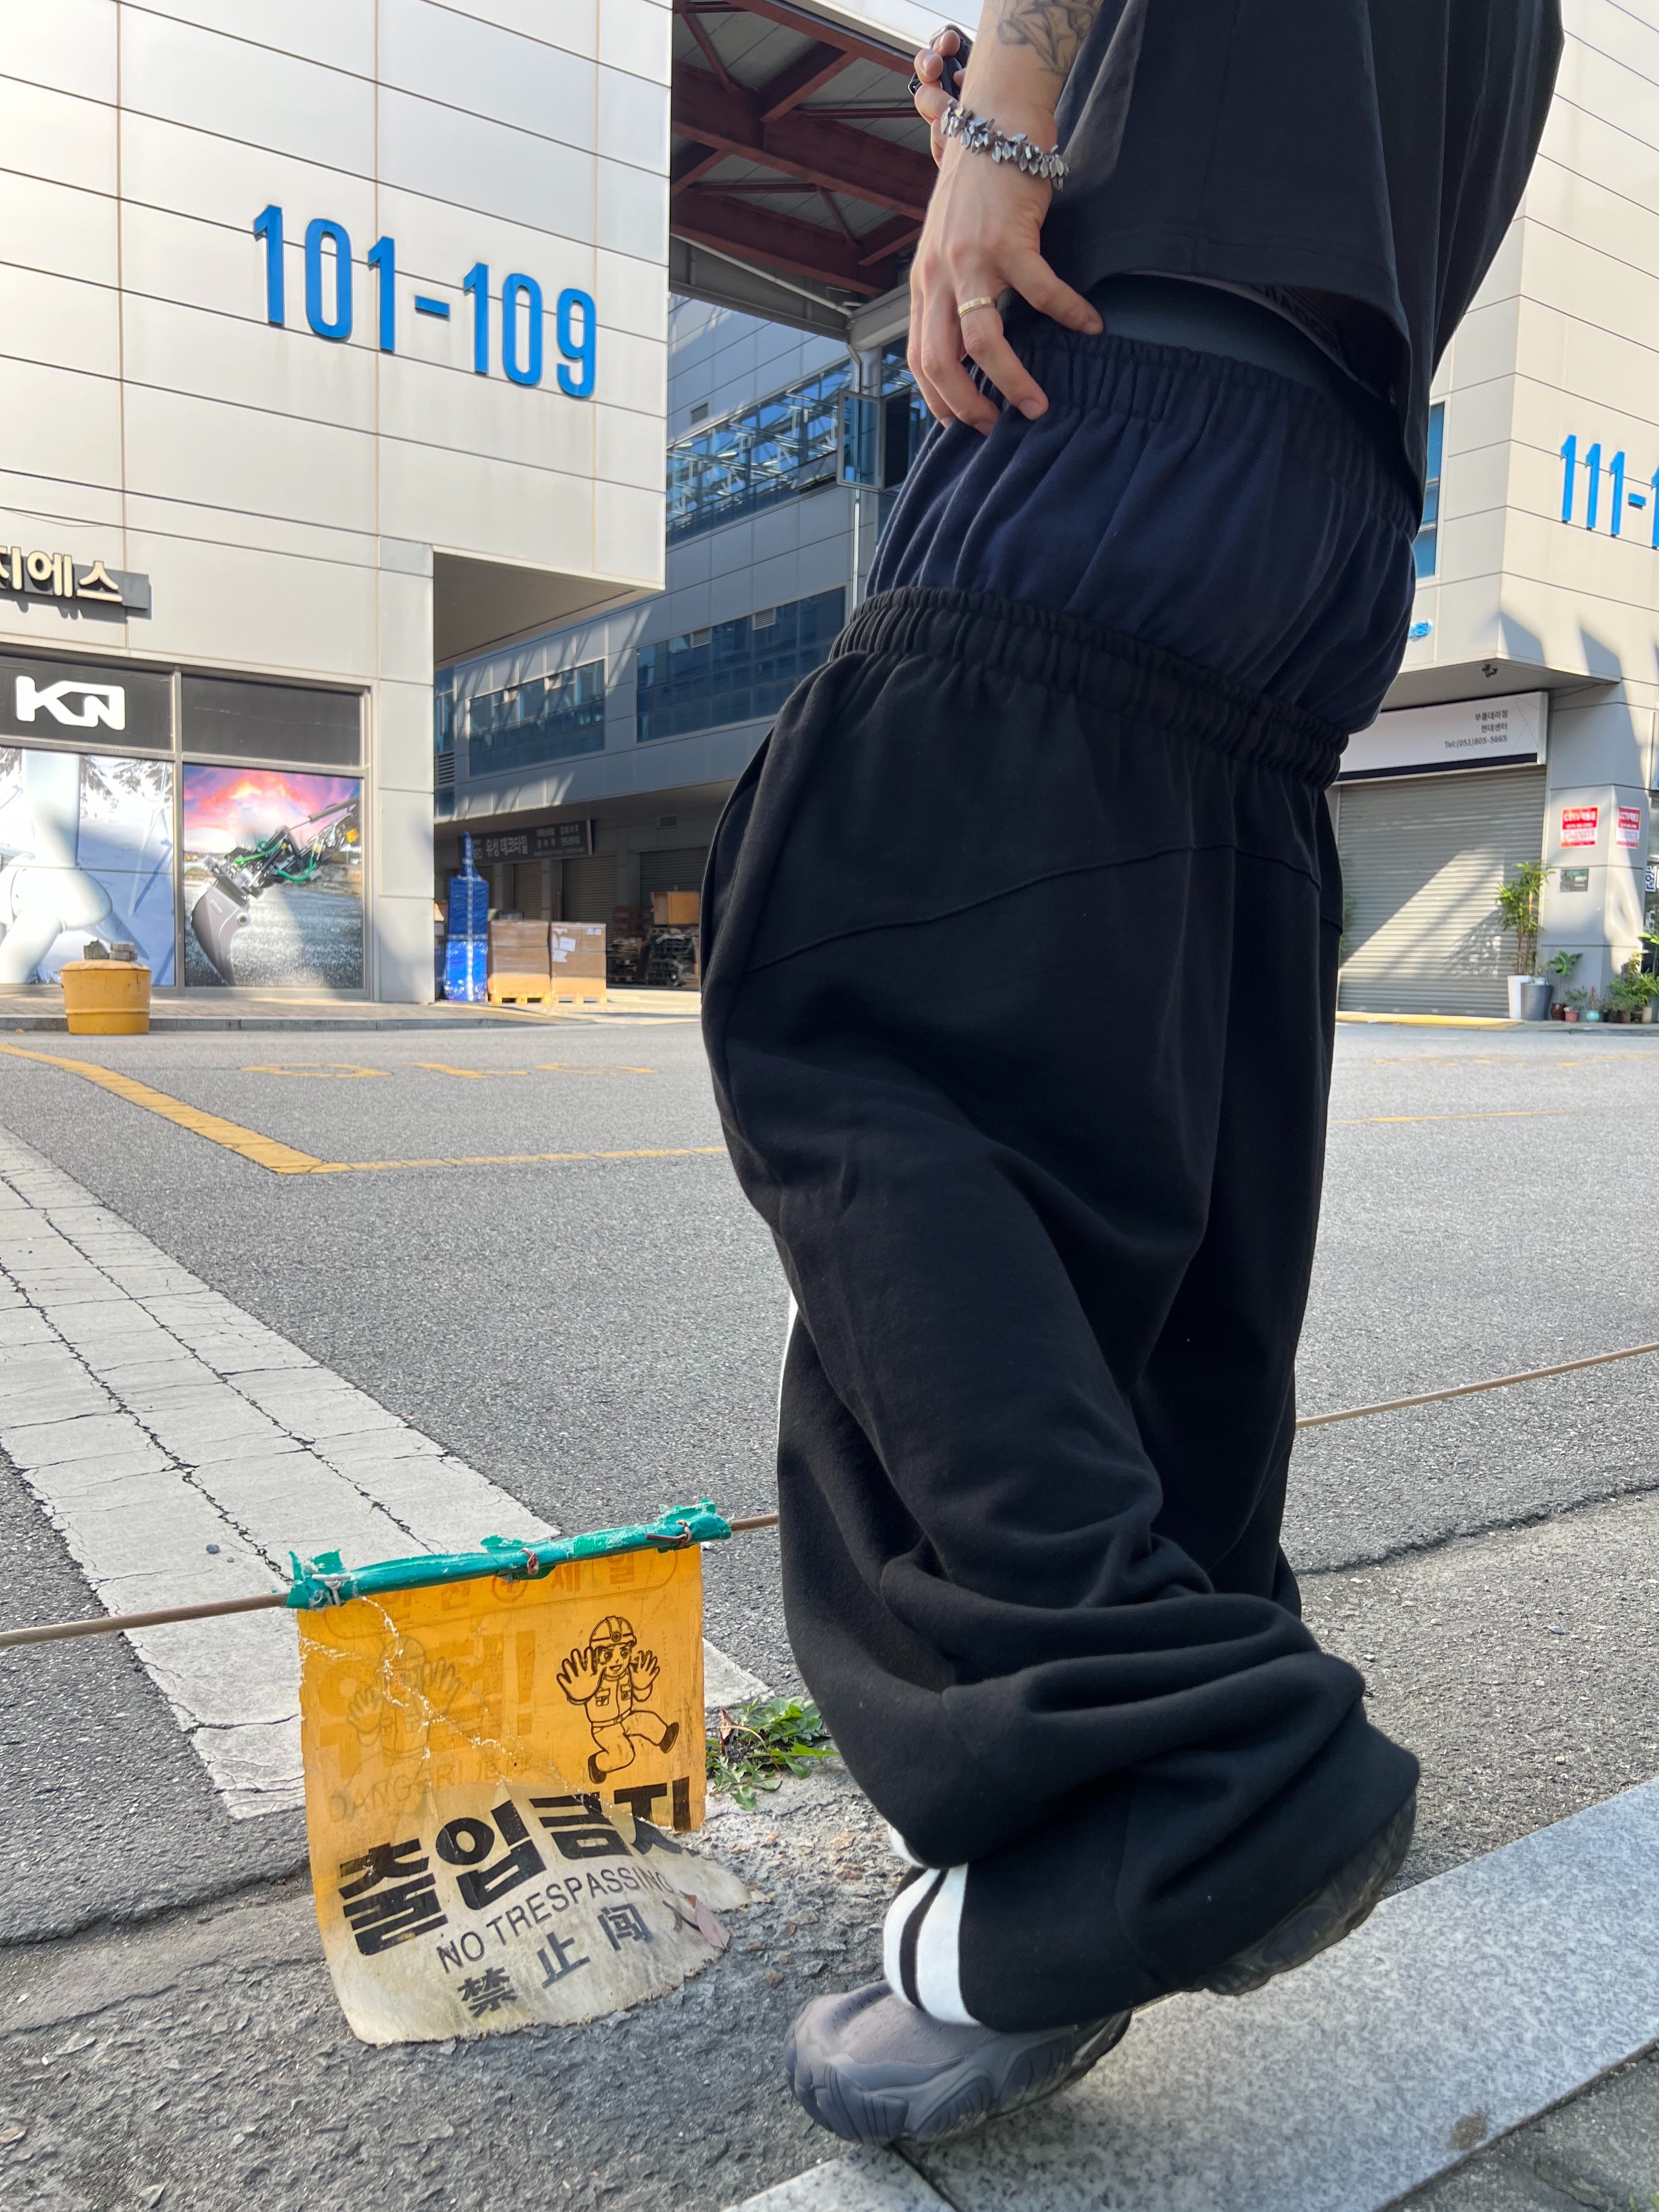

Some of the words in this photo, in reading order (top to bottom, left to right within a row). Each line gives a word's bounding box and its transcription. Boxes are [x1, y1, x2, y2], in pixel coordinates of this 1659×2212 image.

[254, 204, 596, 398] 101-109
[338, 1776, 699, 1955] 출입금지
[436, 1931, 486, 1974] NO
[486, 1866, 674, 1946] TRESPASSING
